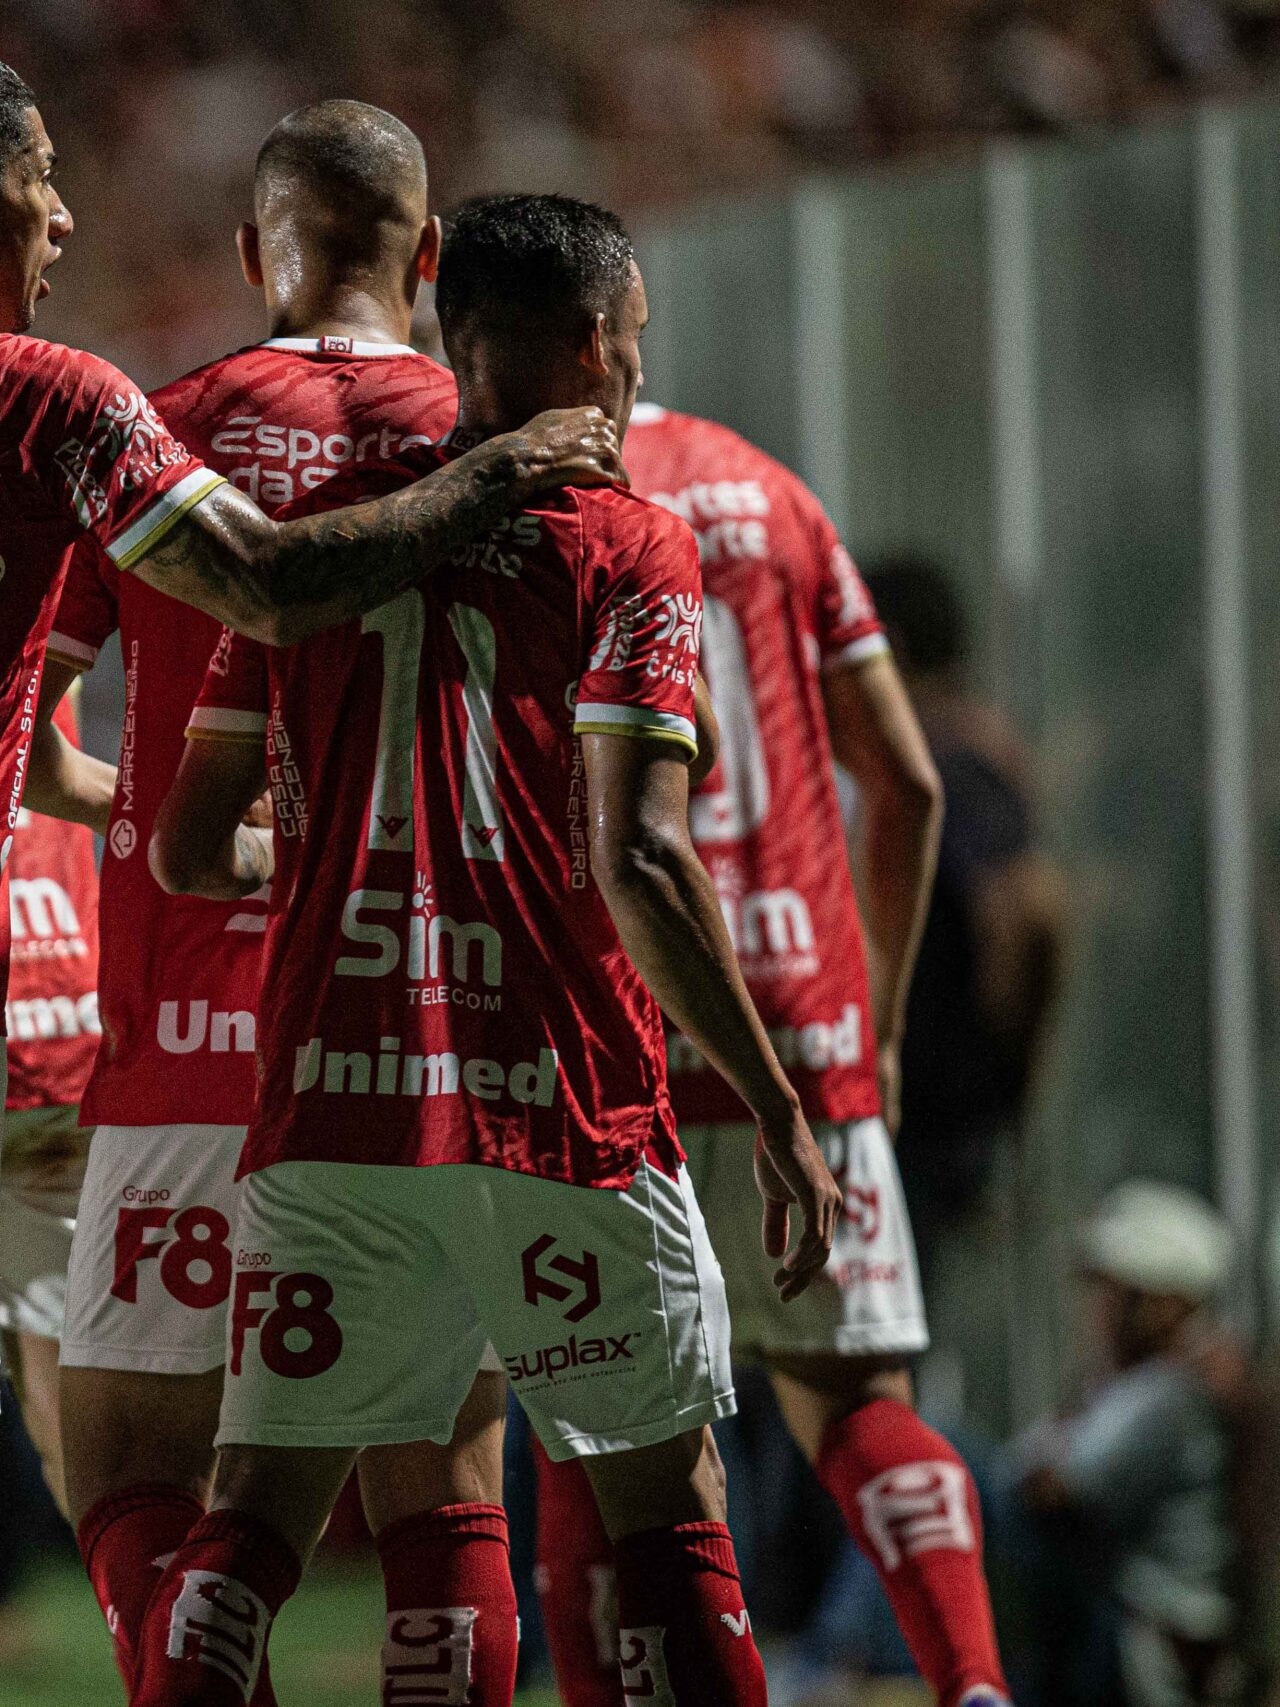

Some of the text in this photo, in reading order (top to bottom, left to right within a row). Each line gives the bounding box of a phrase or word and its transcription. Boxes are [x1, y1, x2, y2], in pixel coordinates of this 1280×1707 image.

[6, 661, 42, 830] OFICIAL SPO
[360, 587, 506, 863] 11
[271, 764, 297, 838] CASA
[333, 888, 503, 987] Sim
[406, 985, 502, 1012] TELECOM
[122, 1185, 170, 1203] Grupo
[110, 1205, 233, 1309] F8
[230, 1270, 344, 1380] F8
